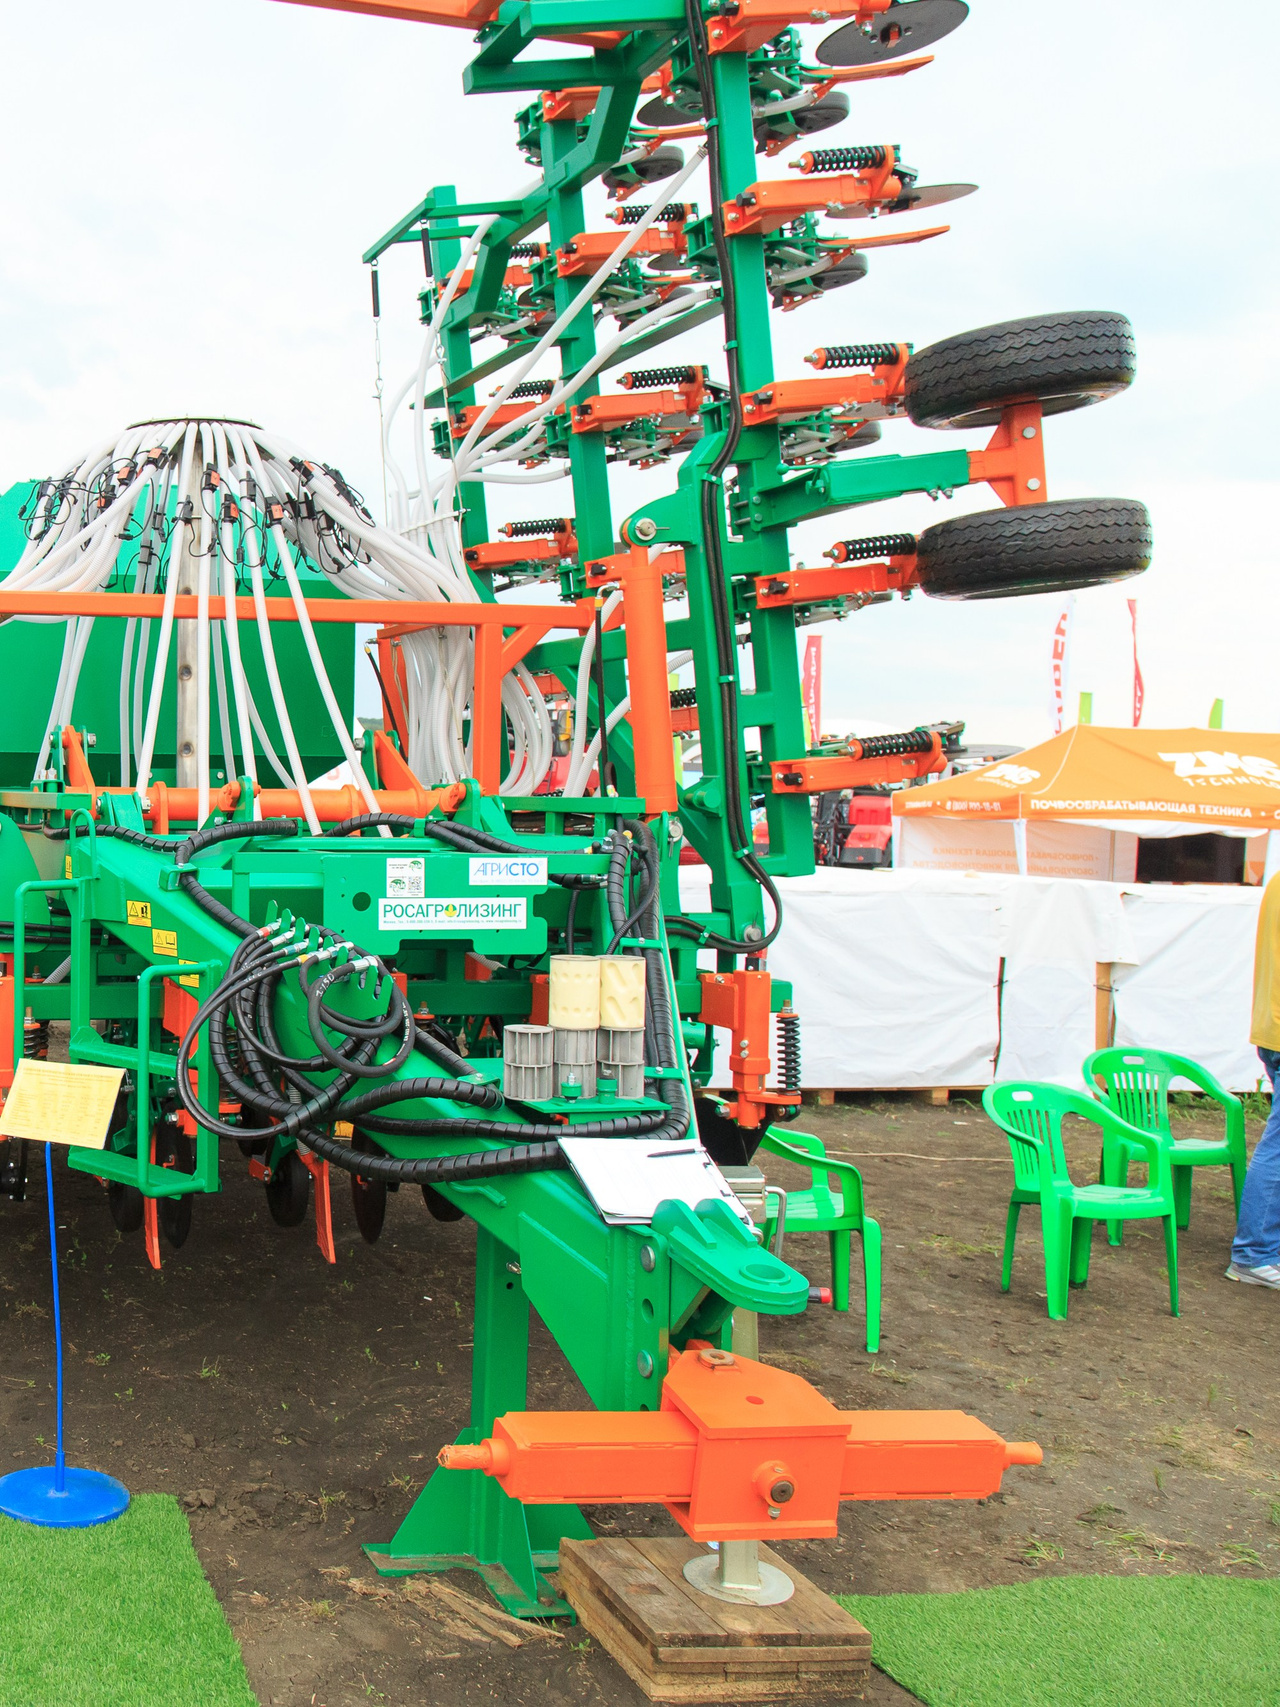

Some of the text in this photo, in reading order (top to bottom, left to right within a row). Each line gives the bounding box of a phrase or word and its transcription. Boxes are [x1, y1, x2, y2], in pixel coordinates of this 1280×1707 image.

[1030, 799, 1252, 818] ПОЧВООБРАБАТЫВАЮЩАЯ ТЕХНИКА
[474, 862, 539, 876] АГРИСТО
[383, 903, 521, 918] РОСАГРОЛИЗИНГ
